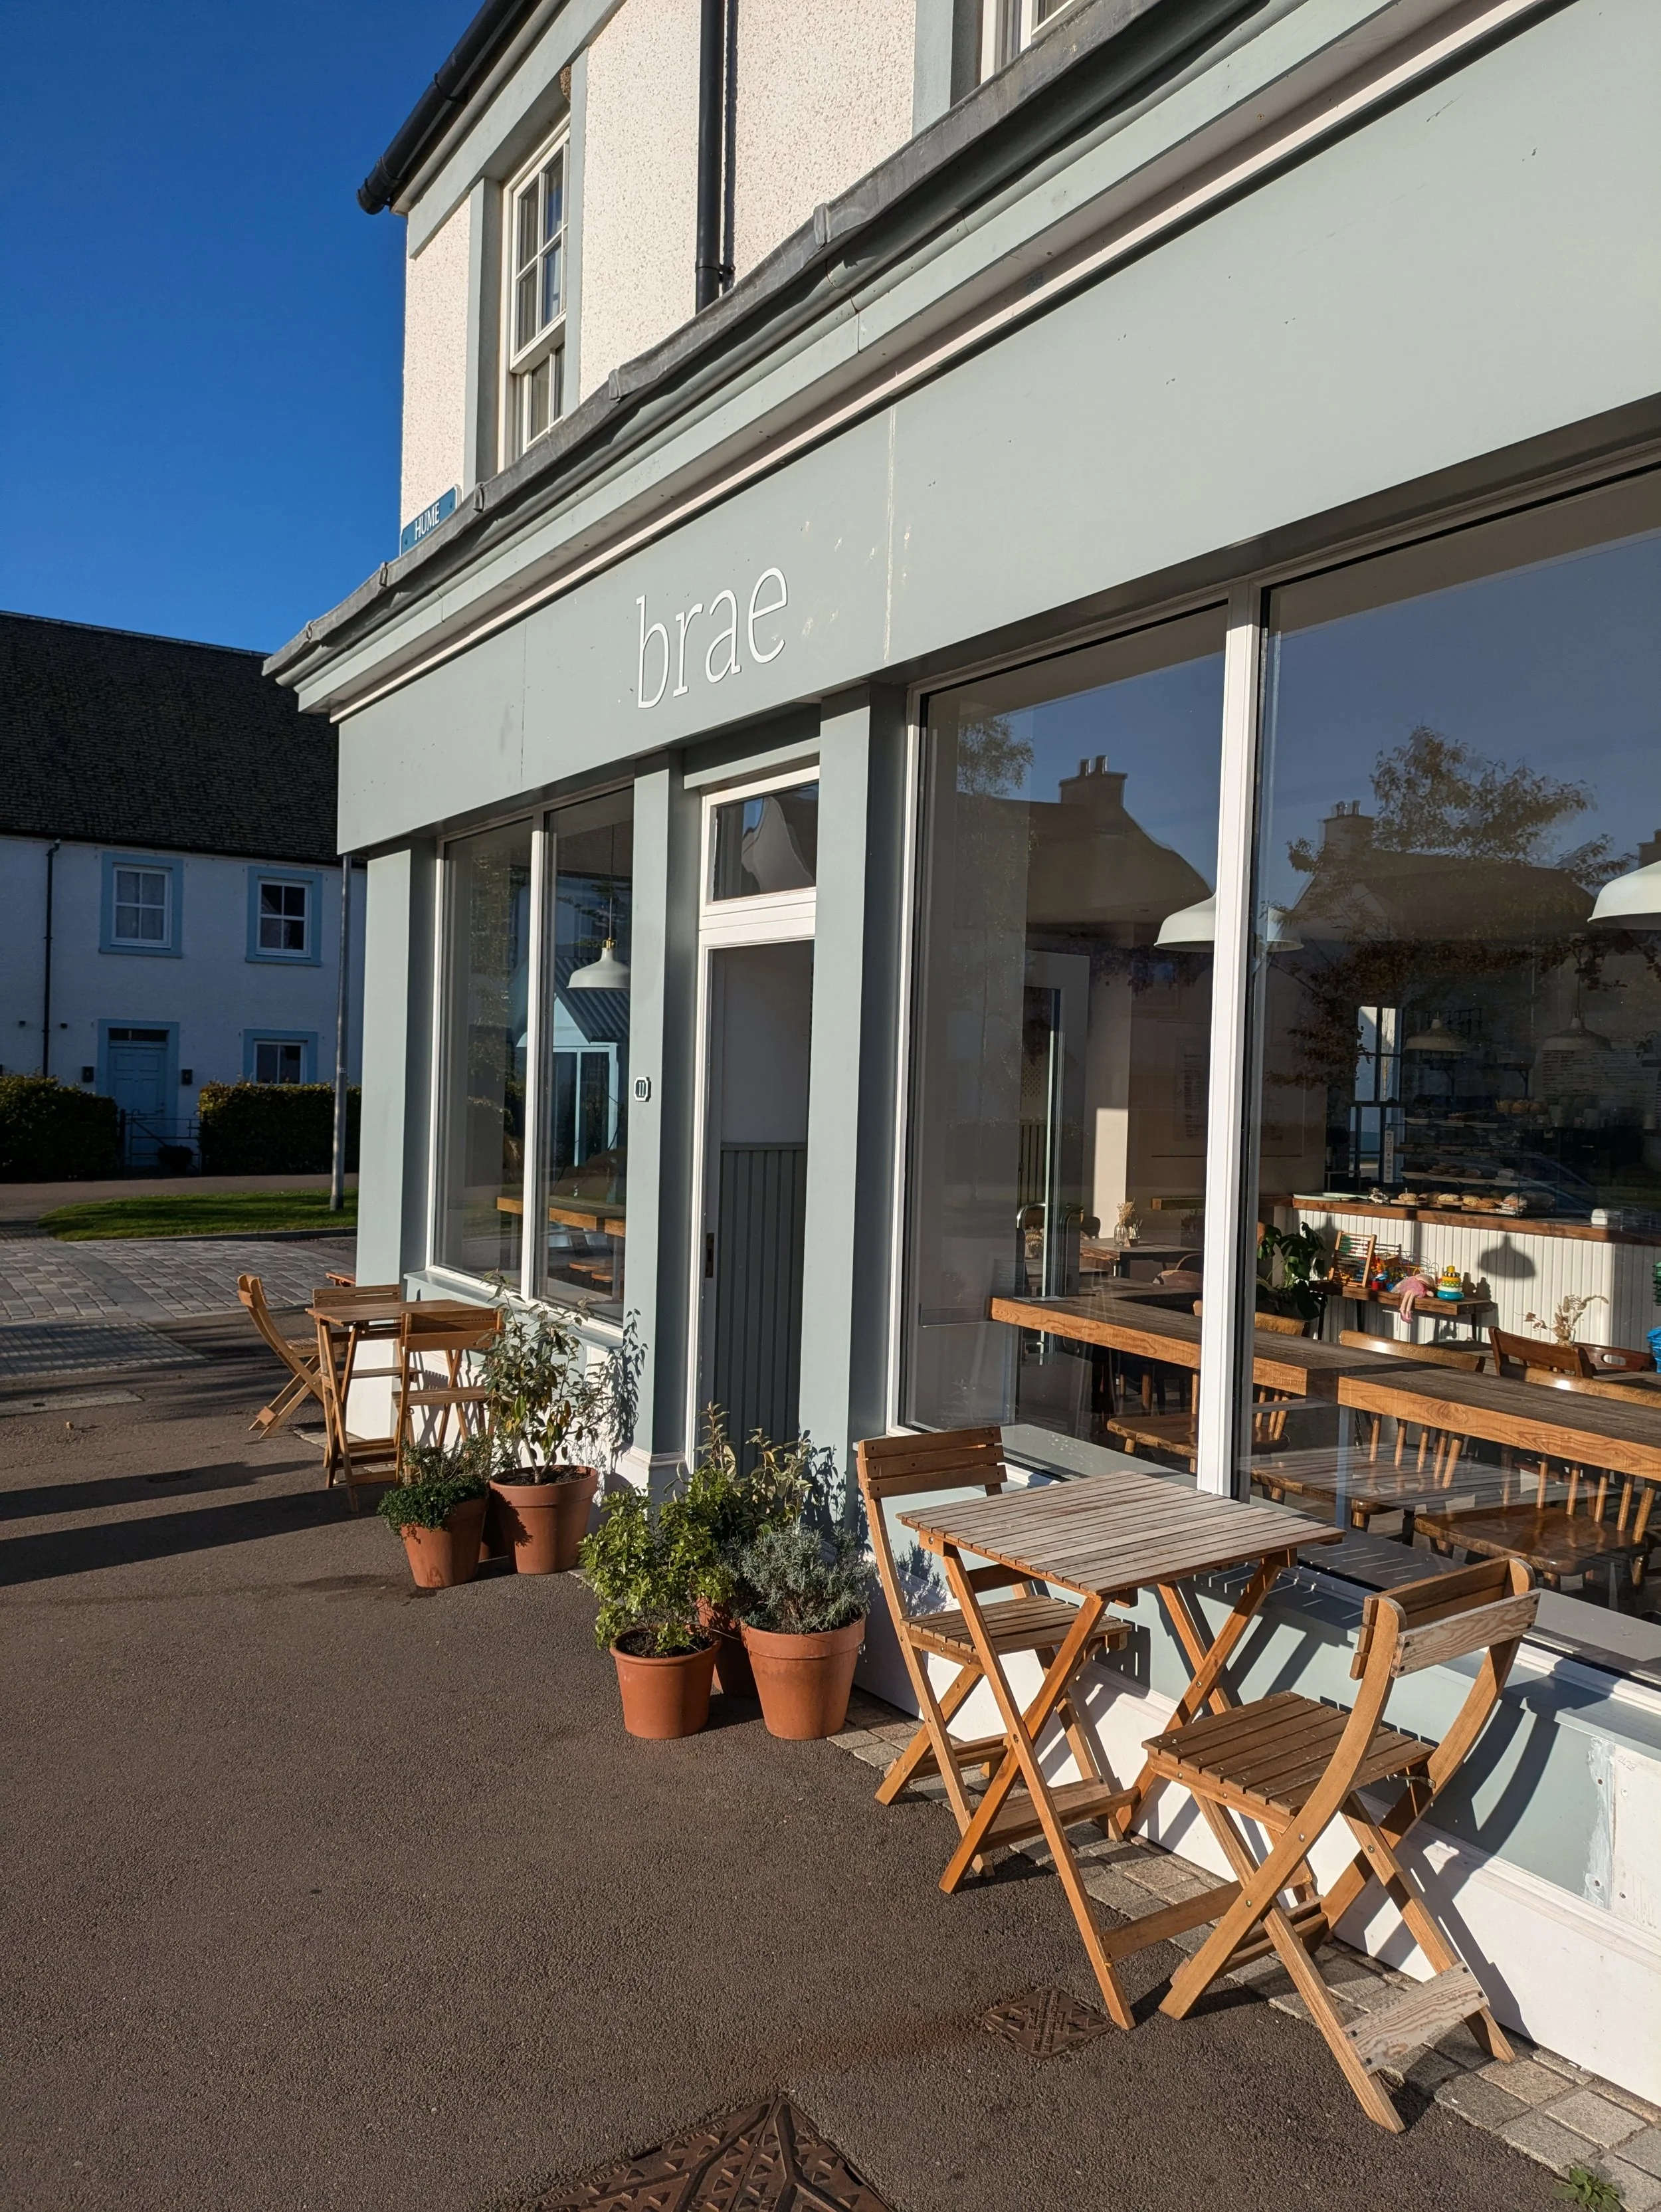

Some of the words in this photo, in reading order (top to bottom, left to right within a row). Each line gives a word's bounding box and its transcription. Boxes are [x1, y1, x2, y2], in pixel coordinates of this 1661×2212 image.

[414, 501, 440, 541] HUME
[636, 567, 788, 709] brae
[638, 1082, 644, 1096] 11
